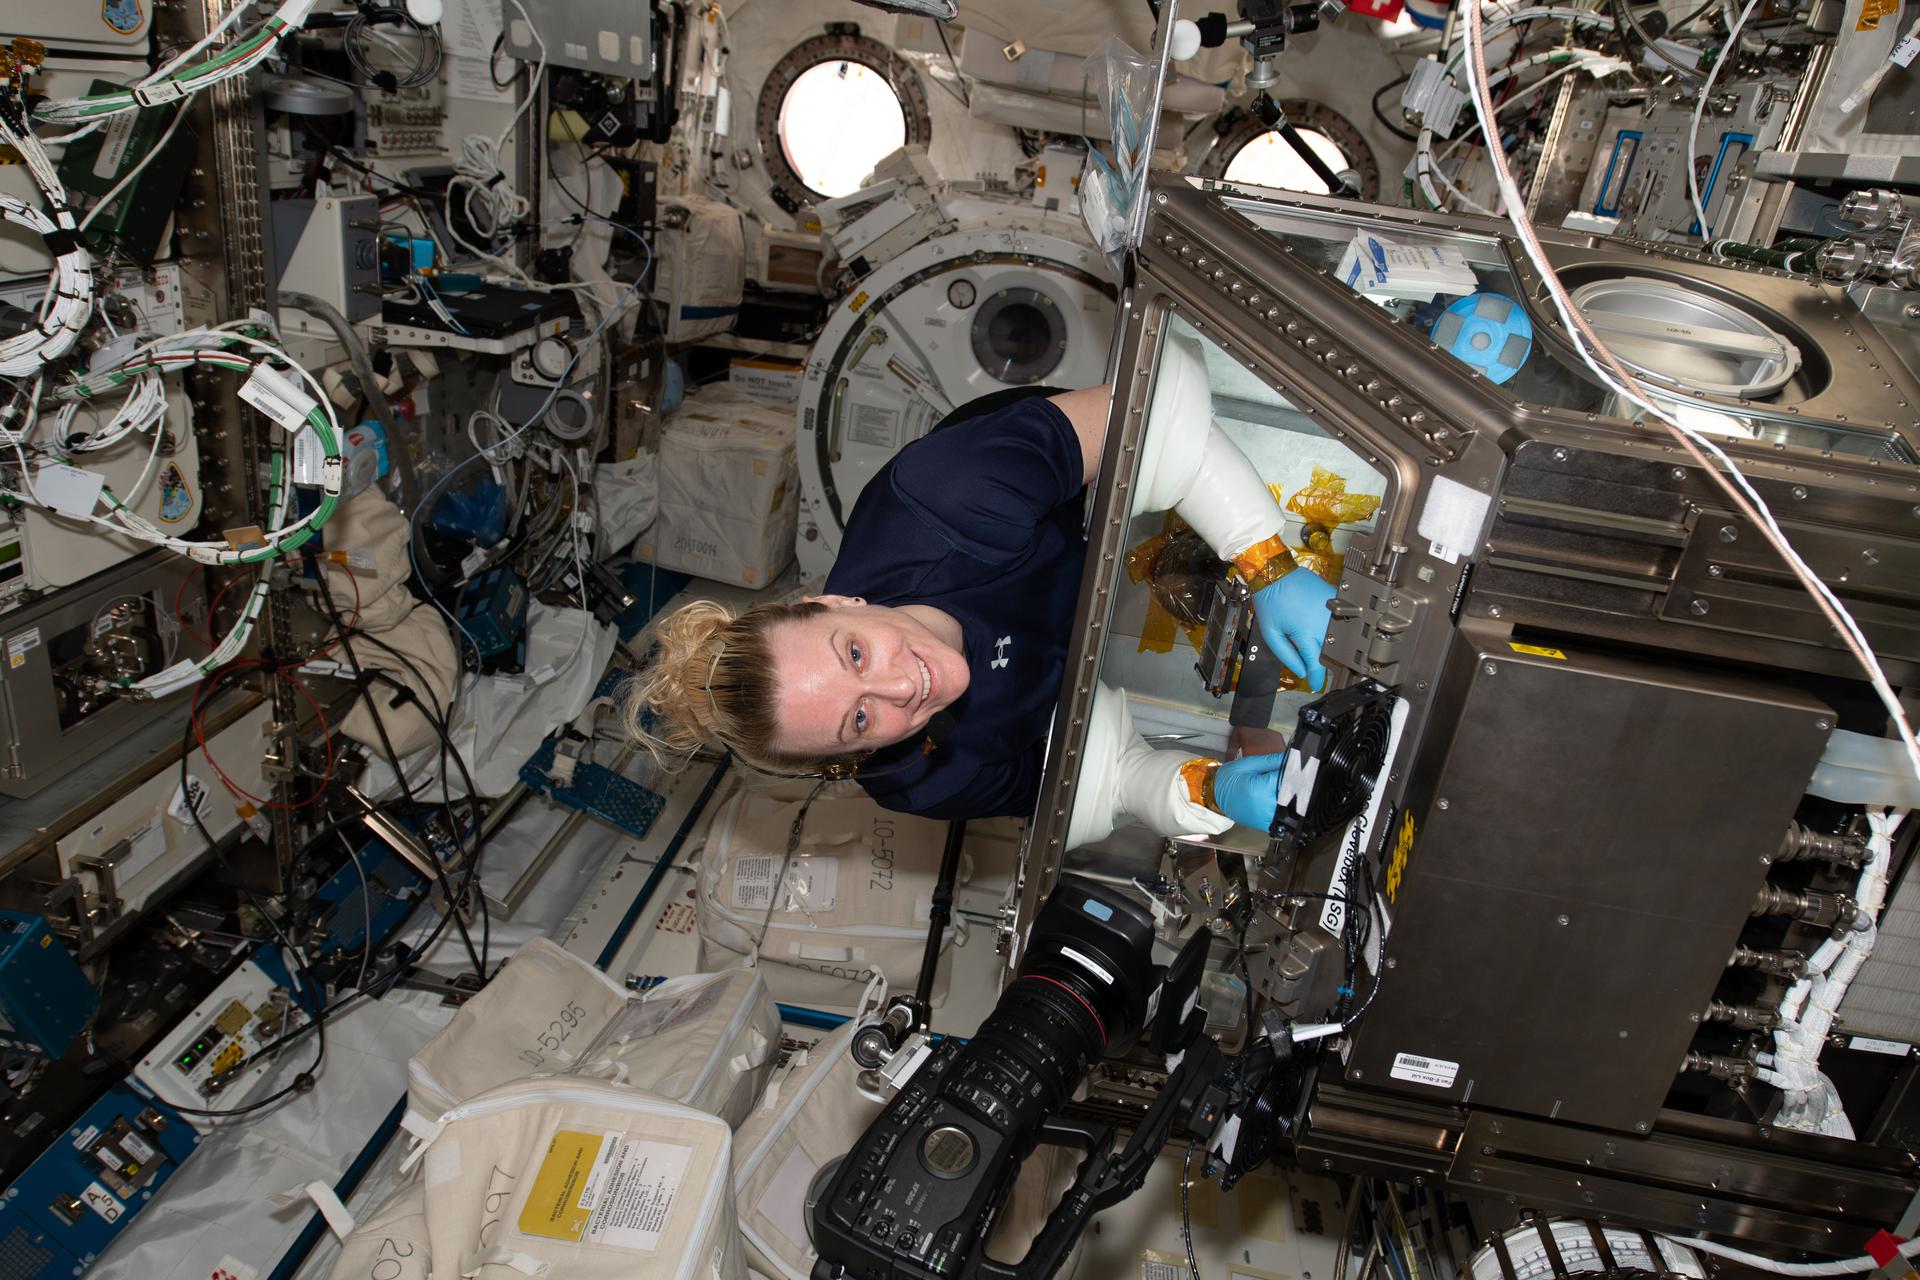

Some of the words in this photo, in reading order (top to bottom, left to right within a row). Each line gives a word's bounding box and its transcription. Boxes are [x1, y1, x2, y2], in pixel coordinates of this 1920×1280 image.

[870, 816, 895, 891] 10-5072
[518, 1000, 586, 1069] 10-5295
[1422, 1075, 1440, 1083] E-Box
[87, 1192, 101, 1205] A
[101, 1194, 114, 1207] 5
[591, 1195, 610, 1235] BACTERIAL
[607, 1160, 624, 1195] ADHESION
[620, 1144, 630, 1159] AND
[600, 1172, 626, 1230] CORROSION/BOB
[104, 1208, 119, 1221] D
